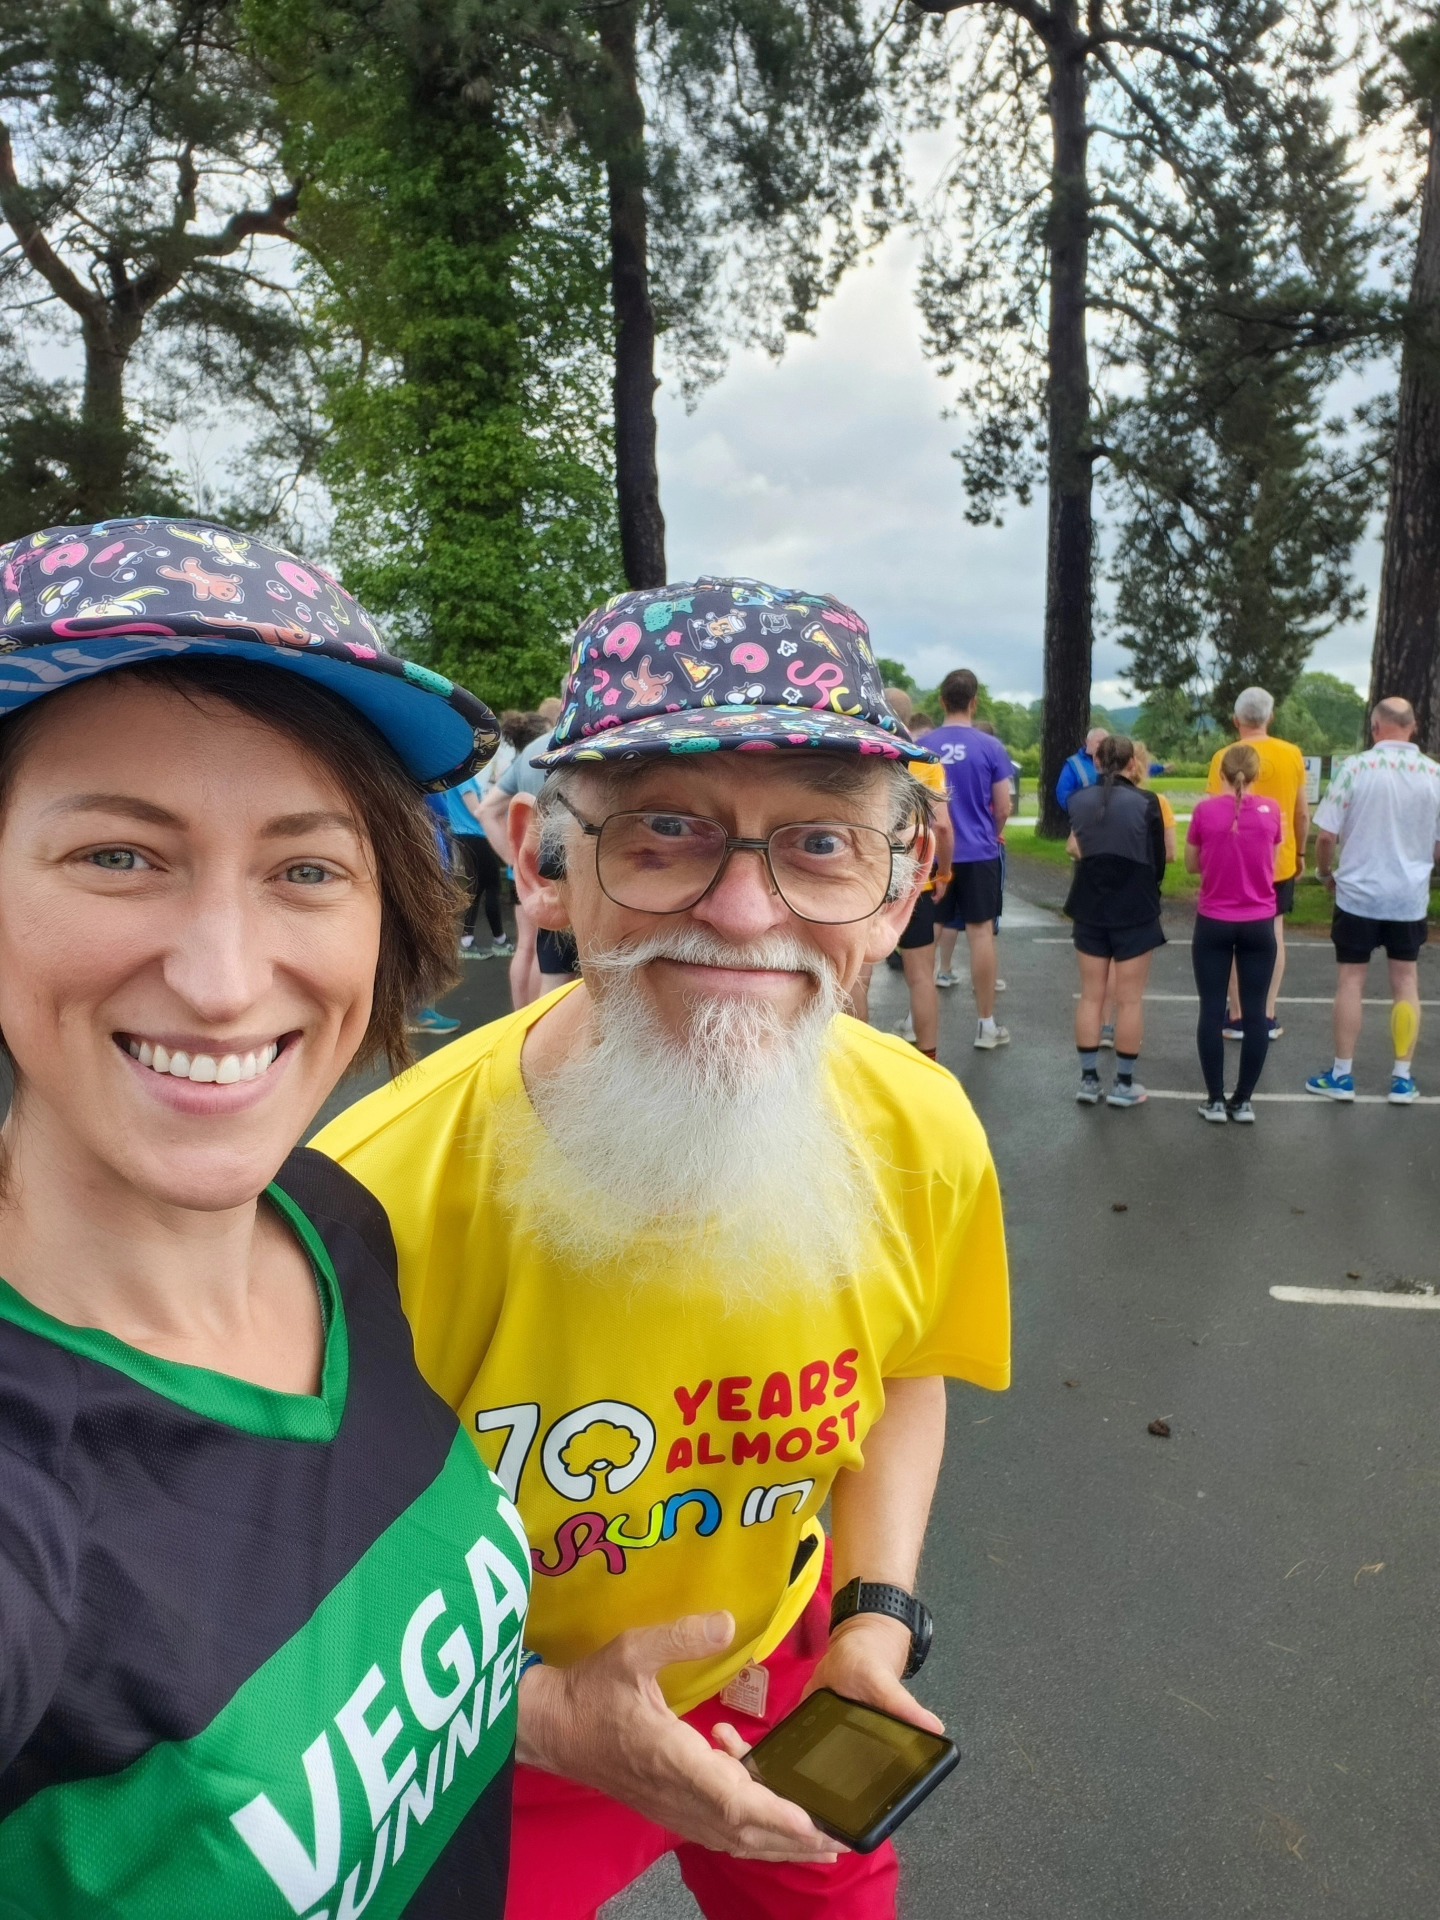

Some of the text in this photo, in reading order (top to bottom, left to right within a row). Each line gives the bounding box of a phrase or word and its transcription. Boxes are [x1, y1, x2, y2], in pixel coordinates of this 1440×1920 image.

[940, 743, 967, 765] 25
[673, 1348, 860, 1427] YEARS
[475, 1399, 656, 1503] 70
[665, 1400, 860, 1474] ALMOST
